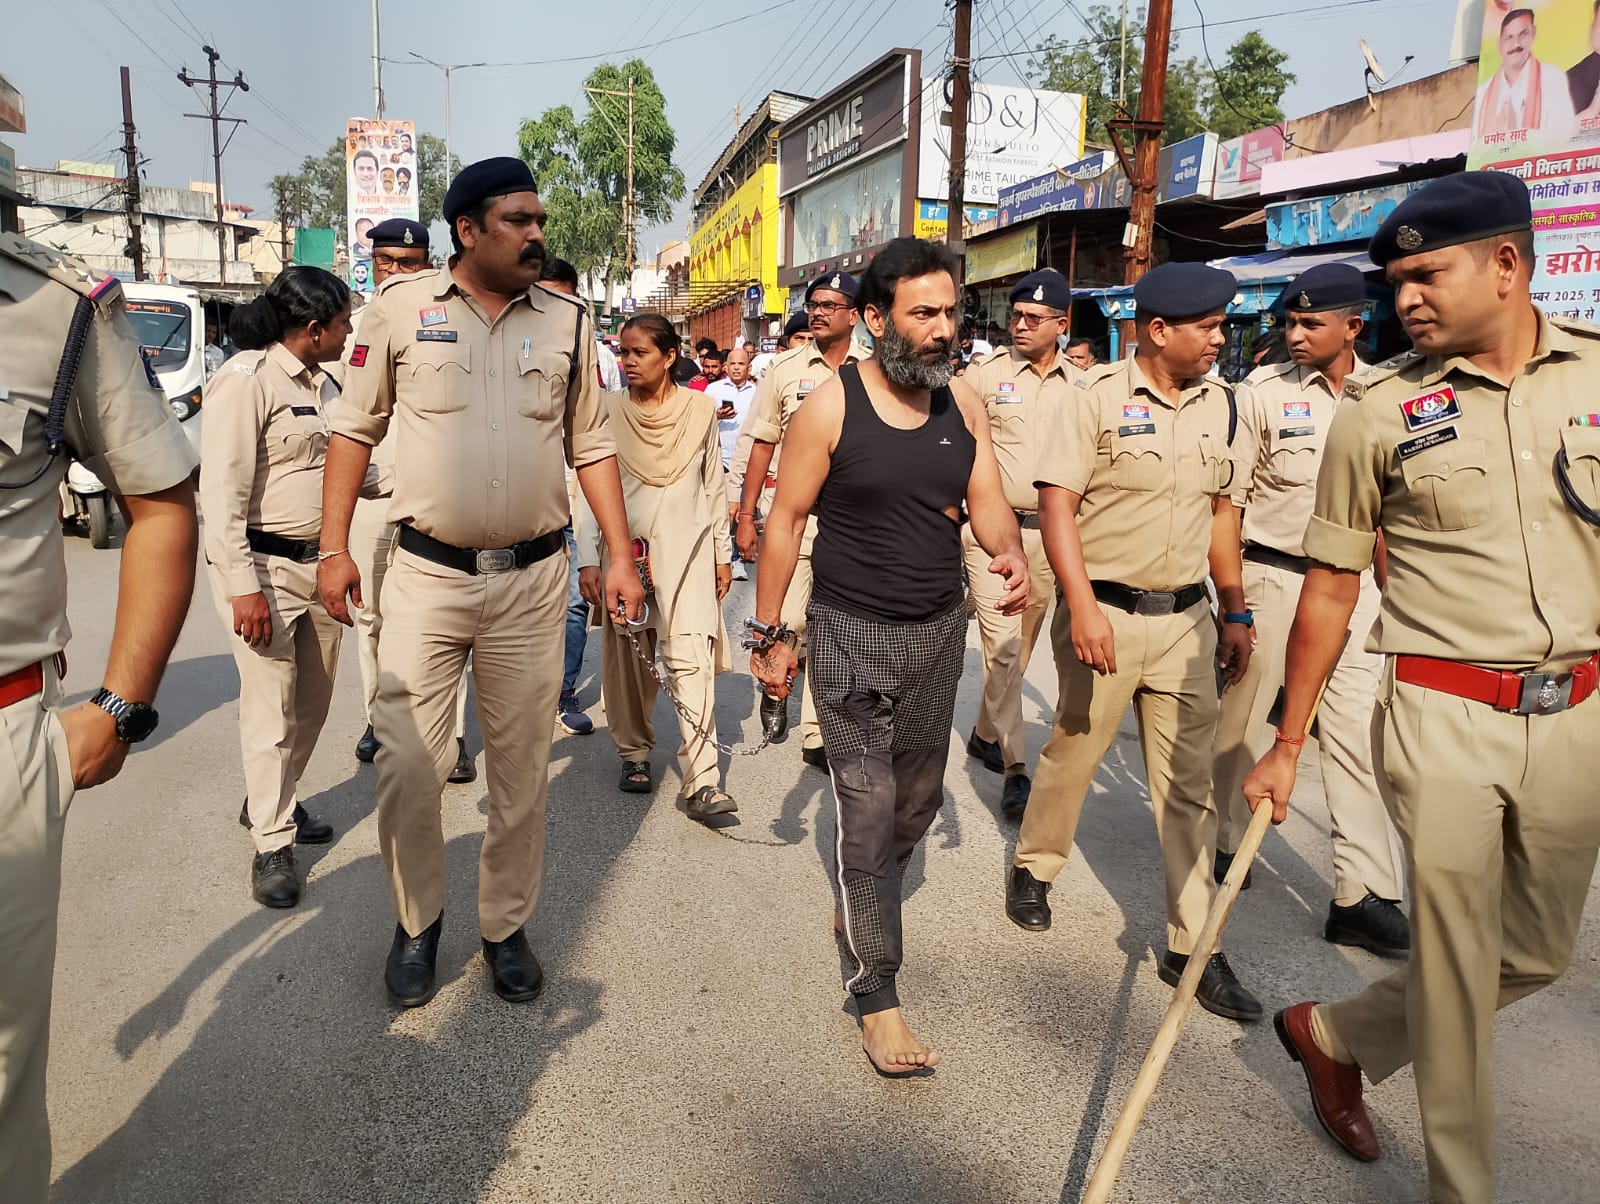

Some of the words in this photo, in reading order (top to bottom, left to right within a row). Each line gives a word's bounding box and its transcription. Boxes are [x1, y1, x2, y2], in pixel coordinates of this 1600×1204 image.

[1029, 98, 1040, 139] J
[806, 96, 863, 163] PRIME
[1536, 158, 1574, 177] मिलन
[964, 170, 992, 182] RIME
[1573, 181, 1590, 195] का
[1529, 292, 1551, 302] म्बर
[1584, 307, 1595, 320] से
